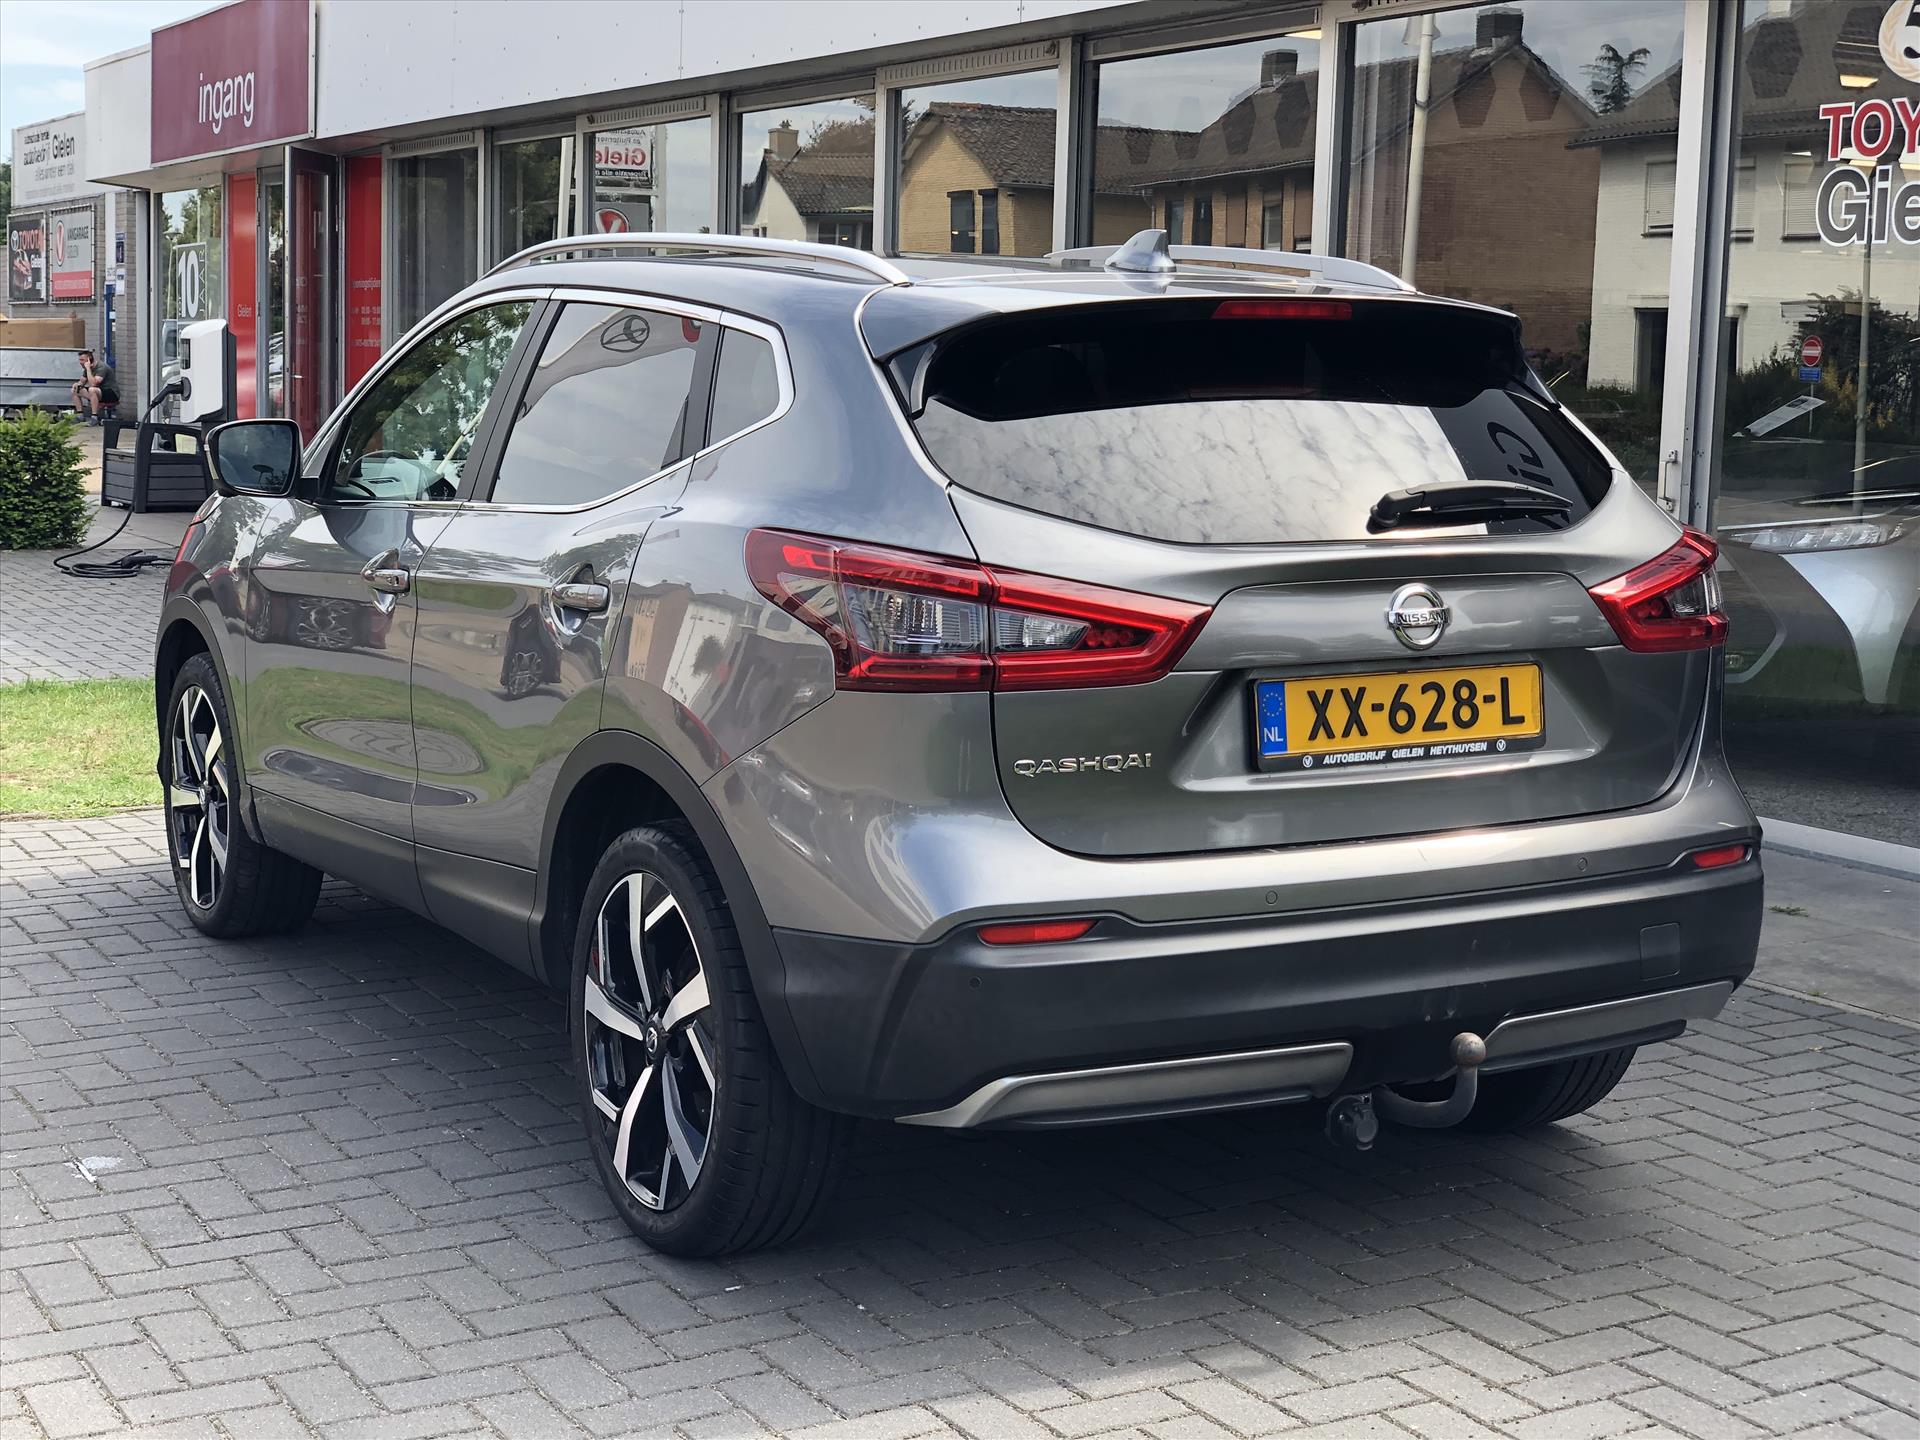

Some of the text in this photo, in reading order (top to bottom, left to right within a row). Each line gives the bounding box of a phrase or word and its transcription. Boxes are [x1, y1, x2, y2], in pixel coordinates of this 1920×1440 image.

[199, 72, 255, 135] ingang
[52, 132, 75, 159] Gielen
[178, 250, 199, 318] 10
[1396, 609, 1446, 624] NISSAN
[1306, 677, 1526, 741] XX-628-L
[1263, 726, 1284, 744] NL
[1013, 753, 1152, 778] QASHQAI
[1323, 751, 1386, 765] AUTOBEDRIJF
[1392, 747, 1424, 760] GIELEN
[1430, 742, 1488, 756] HEYTHUYSEN
